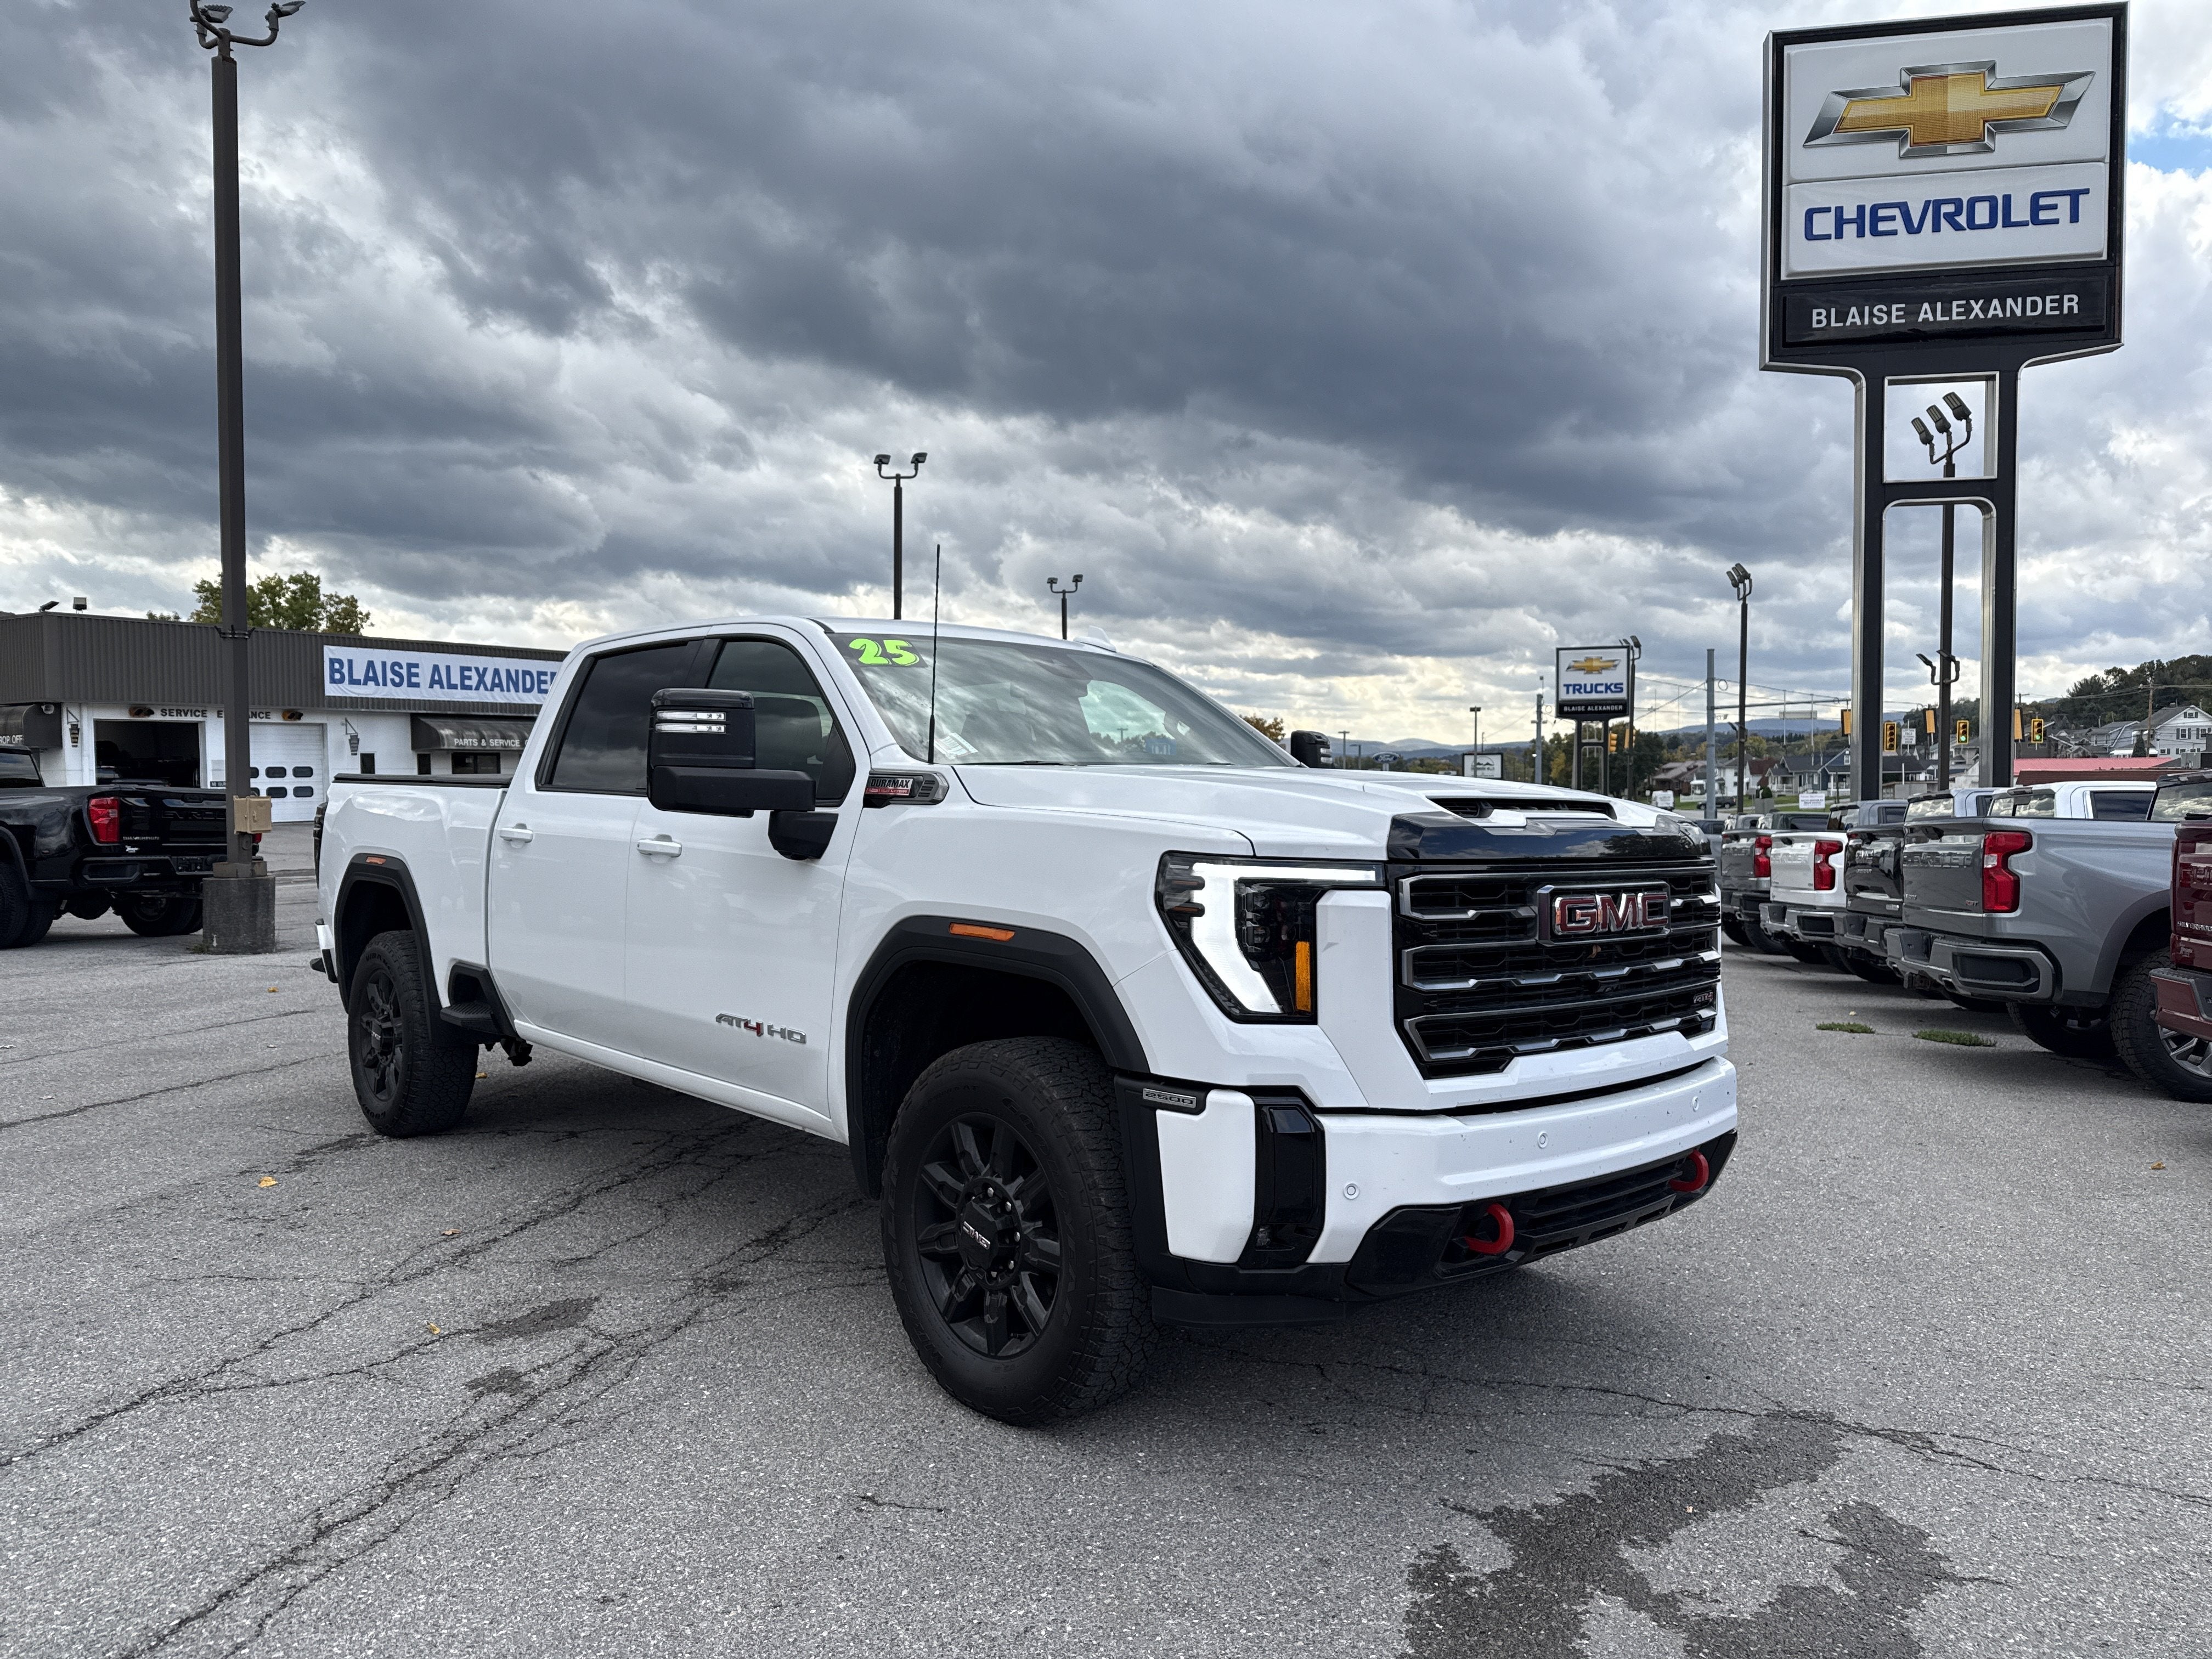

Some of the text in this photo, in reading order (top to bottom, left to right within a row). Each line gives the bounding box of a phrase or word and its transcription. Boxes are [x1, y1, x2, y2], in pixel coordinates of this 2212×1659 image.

[1804, 188, 2090, 241] CHEVROLET
[1812, 294, 2079, 328] BLAISE ALEXANDER
[849, 638, 919, 666] 25
[329, 658, 420, 688] BLAISE
[1563, 682, 1624, 695] TRUCKS
[160, 708, 207, 718] SERVICE
[12, 735, 23, 744] OFF
[871, 779, 910, 788] DURAMAX
[1555, 893, 1668, 935] GMC
[715, 1012, 807, 1043] AT4 HD
[1145, 1092, 1193, 1104] 2500
